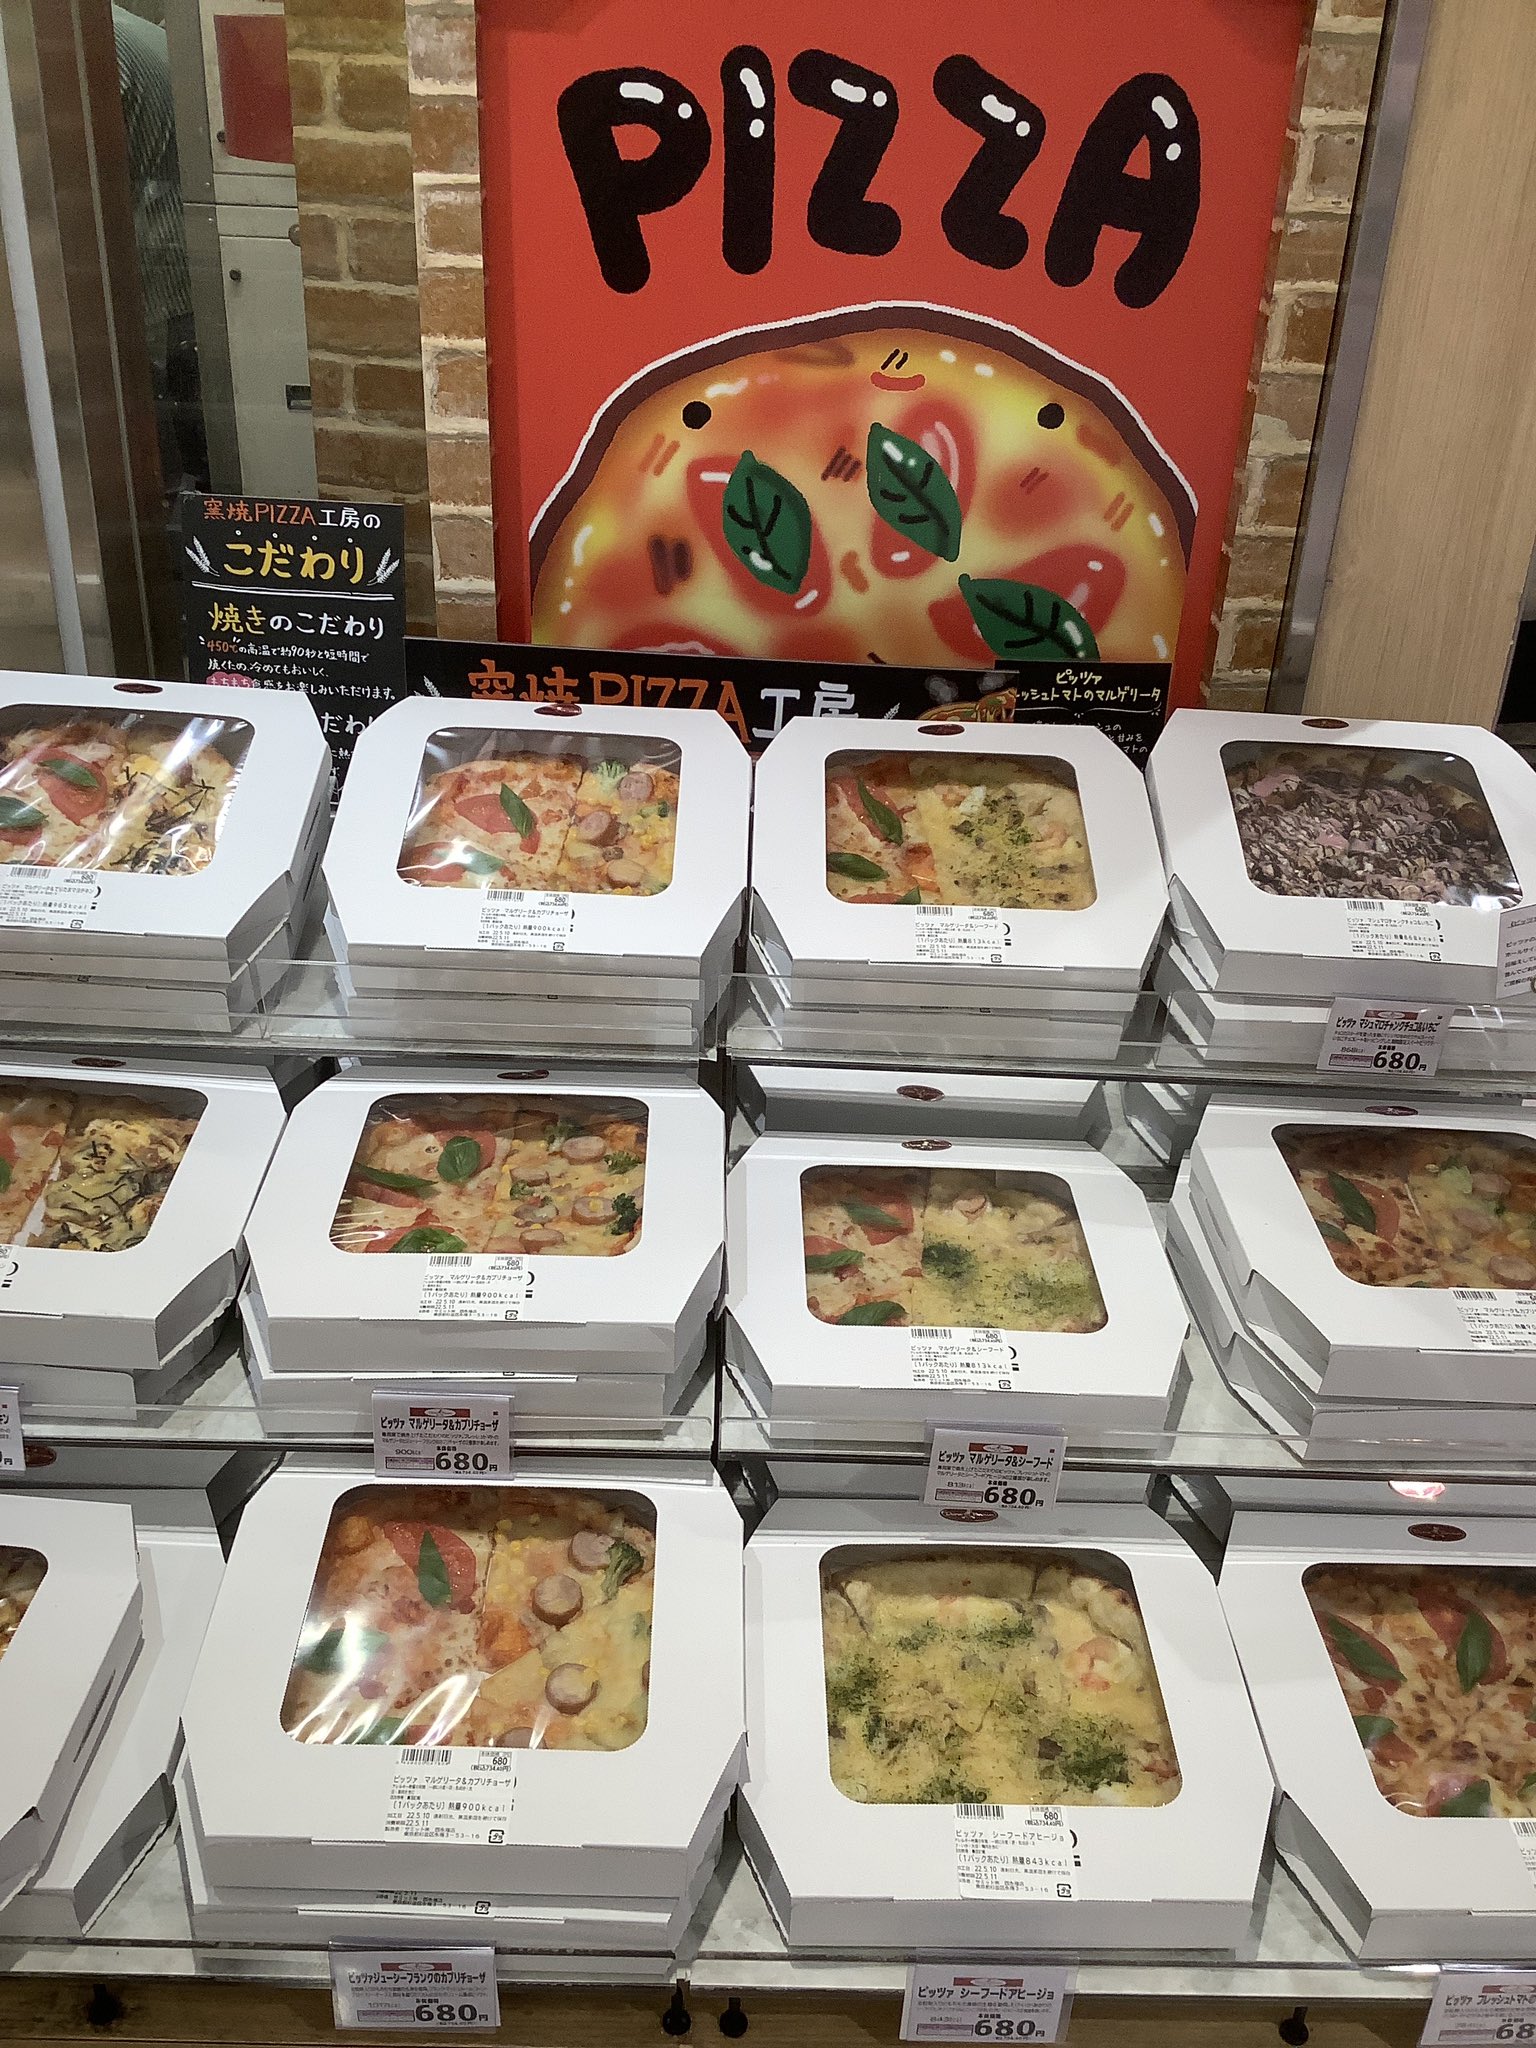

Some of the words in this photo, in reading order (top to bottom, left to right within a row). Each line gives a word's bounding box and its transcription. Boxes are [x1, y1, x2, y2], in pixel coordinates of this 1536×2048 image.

[557, 44, 1201, 309] PIZZA
[203, 499, 381, 529] 窯焼PIZZA工房の
[224, 540, 363, 584] こだわり
[211, 601, 385, 639] 焼きのこだわり
[1056, 669, 1102, 685] ピッツァ
[380, 1416, 405, 1429] ピッツァ
[938, 1450, 965, 1463] ピッツァ
[492, 1757, 508, 1765] 680
[1044, 1811, 1058, 1820] 680
[918, 1986, 954, 1998] ピッツァ
[960, 1988, 1054, 2000] シーフードアヒージョ
